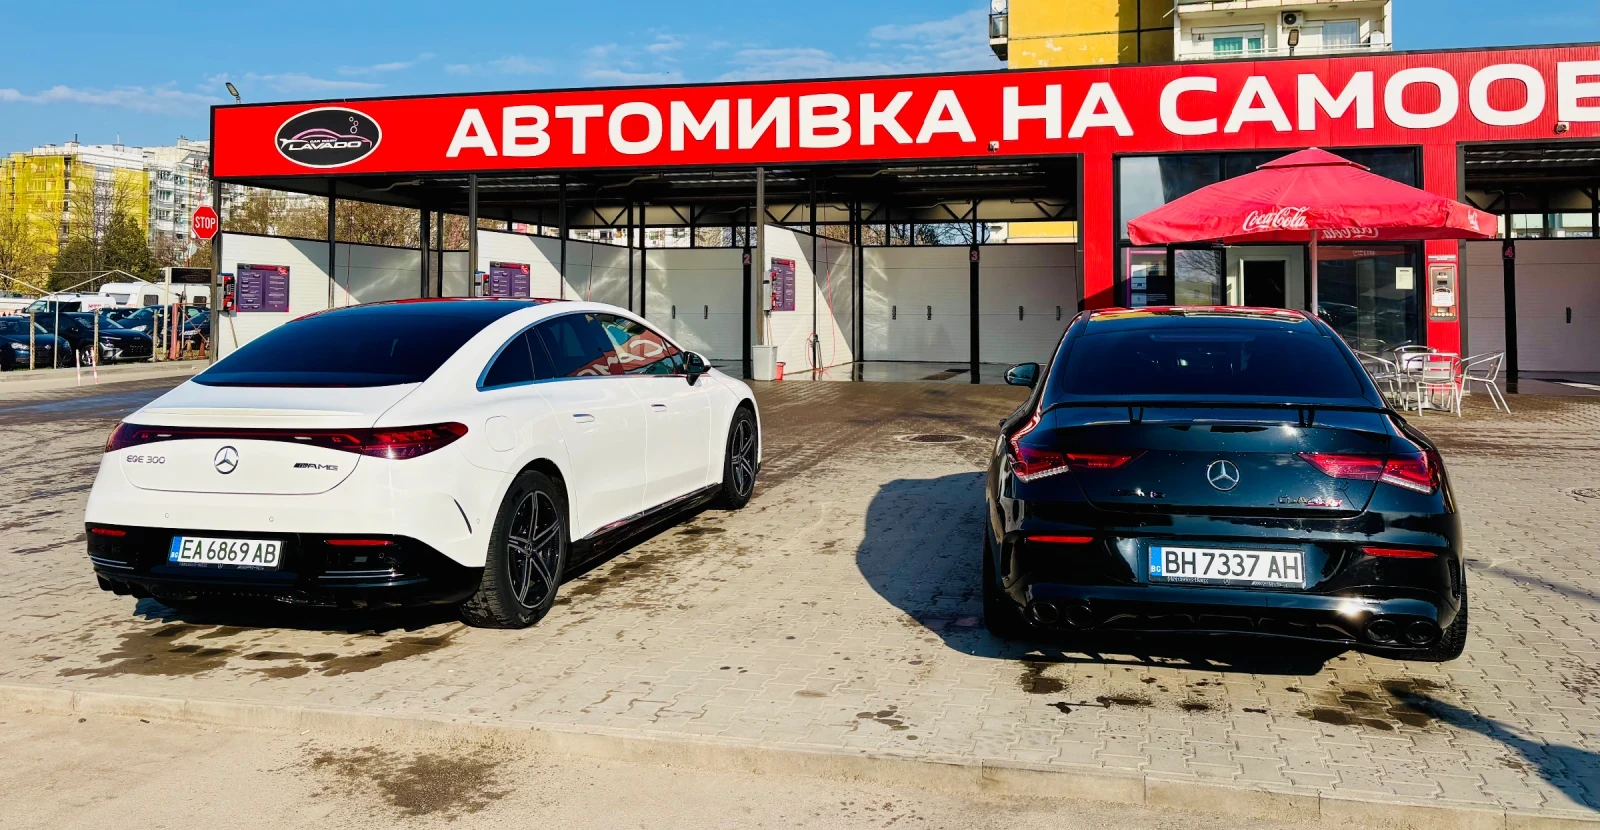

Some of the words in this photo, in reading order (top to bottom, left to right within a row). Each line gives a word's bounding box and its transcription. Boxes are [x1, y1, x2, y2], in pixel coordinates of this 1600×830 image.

[446, 89, 976, 158] АВТОМИВКА
[1003, 82, 1134, 140] НА
[289, 140, 362, 151] LAVADO
[195, 216, 216, 230] STOP
[1242, 206, 1311, 231] Coca-Cola
[971, 250, 978, 261] 3
[1504, 246, 1514, 258] 4
[743, 253, 751, 264] 2
[146, 455, 166, 464] 300
[305, 463, 338, 471] AMG
[181, 539, 202, 560] EA
[207, 540, 250, 562] 6869
[252, 543, 276, 564] AB
[1150, 565, 1161, 573] BG
[1165, 551, 1196, 575] BH
[1202, 552, 1260, 578] 7337
[1268, 556, 1299, 580] AH
